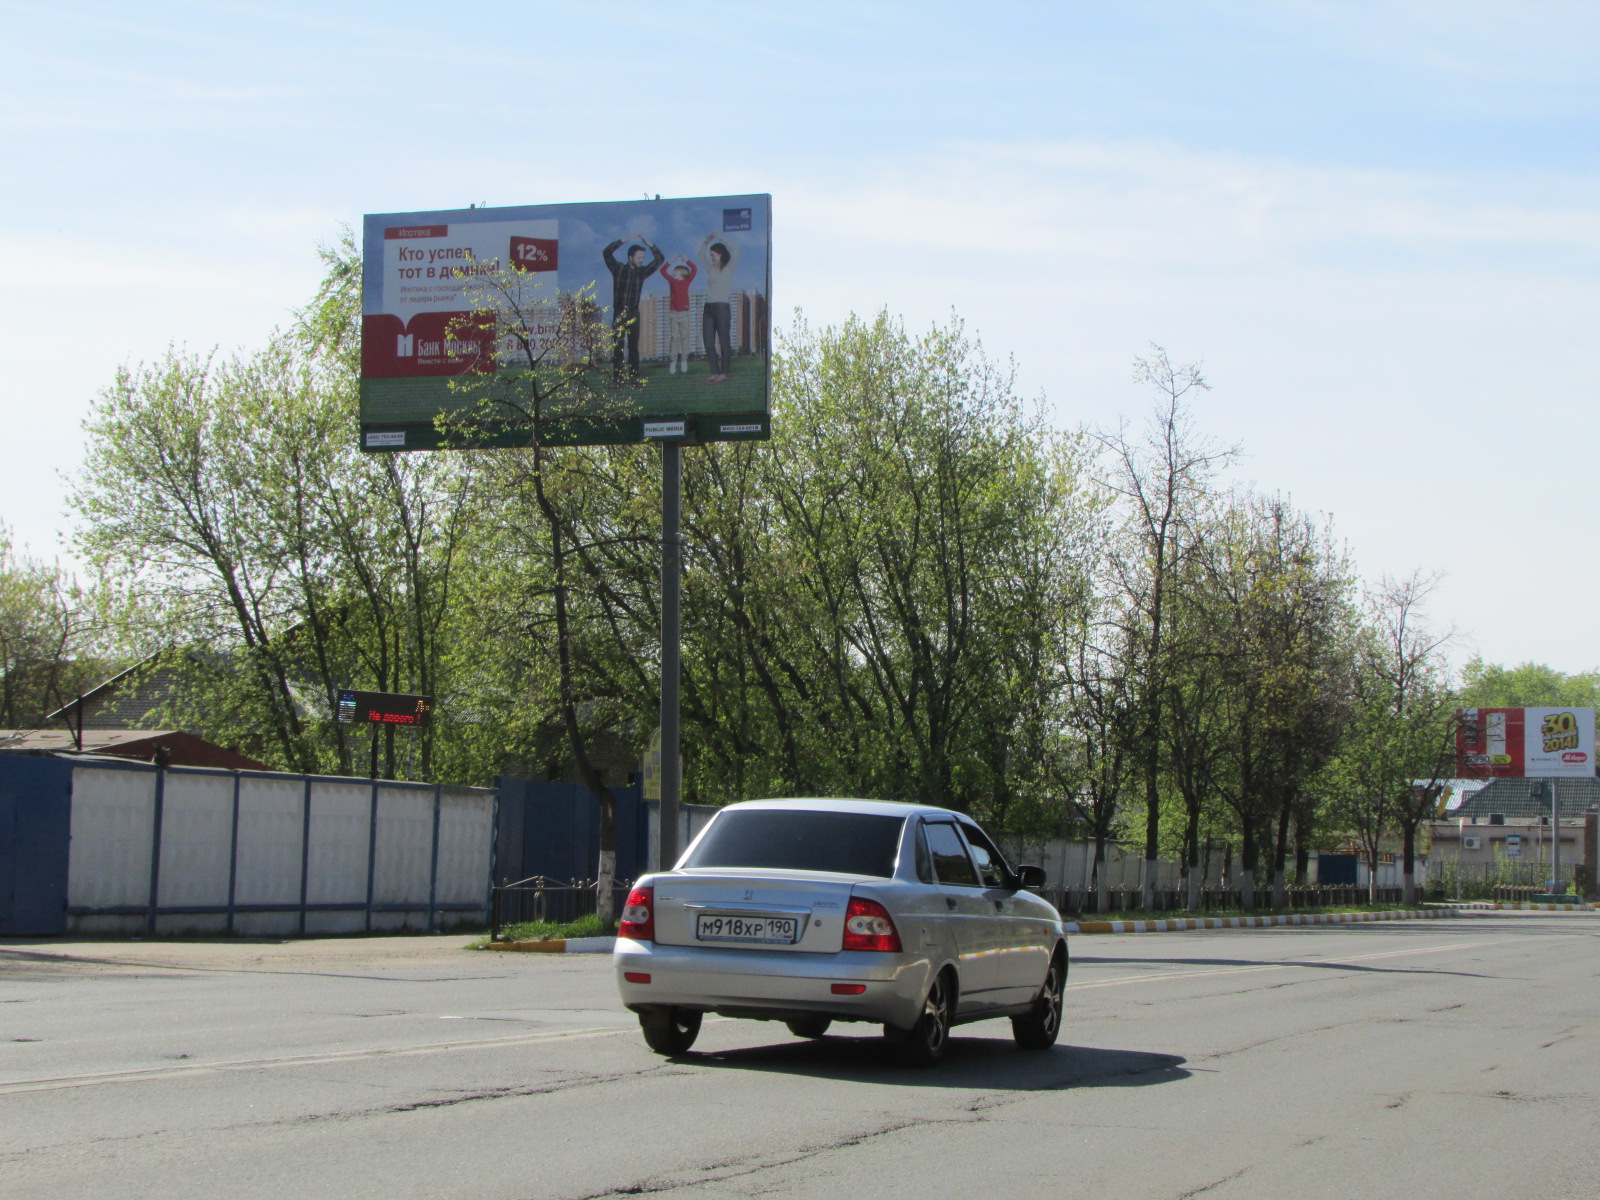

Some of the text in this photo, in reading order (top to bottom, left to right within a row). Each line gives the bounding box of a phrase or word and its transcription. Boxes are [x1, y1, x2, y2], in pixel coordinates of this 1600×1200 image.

[399, 228, 431, 237] Ипотека
[399, 247, 477, 264] Кто успел,
[517, 243, 548, 262] 12%
[398, 267, 422, 279] тот
[426, 266, 436, 278] в
[418, 338, 481, 356] Банк Москвы
[1543, 737, 1573, 752] 2014
[767, 920, 791, 933] 190
